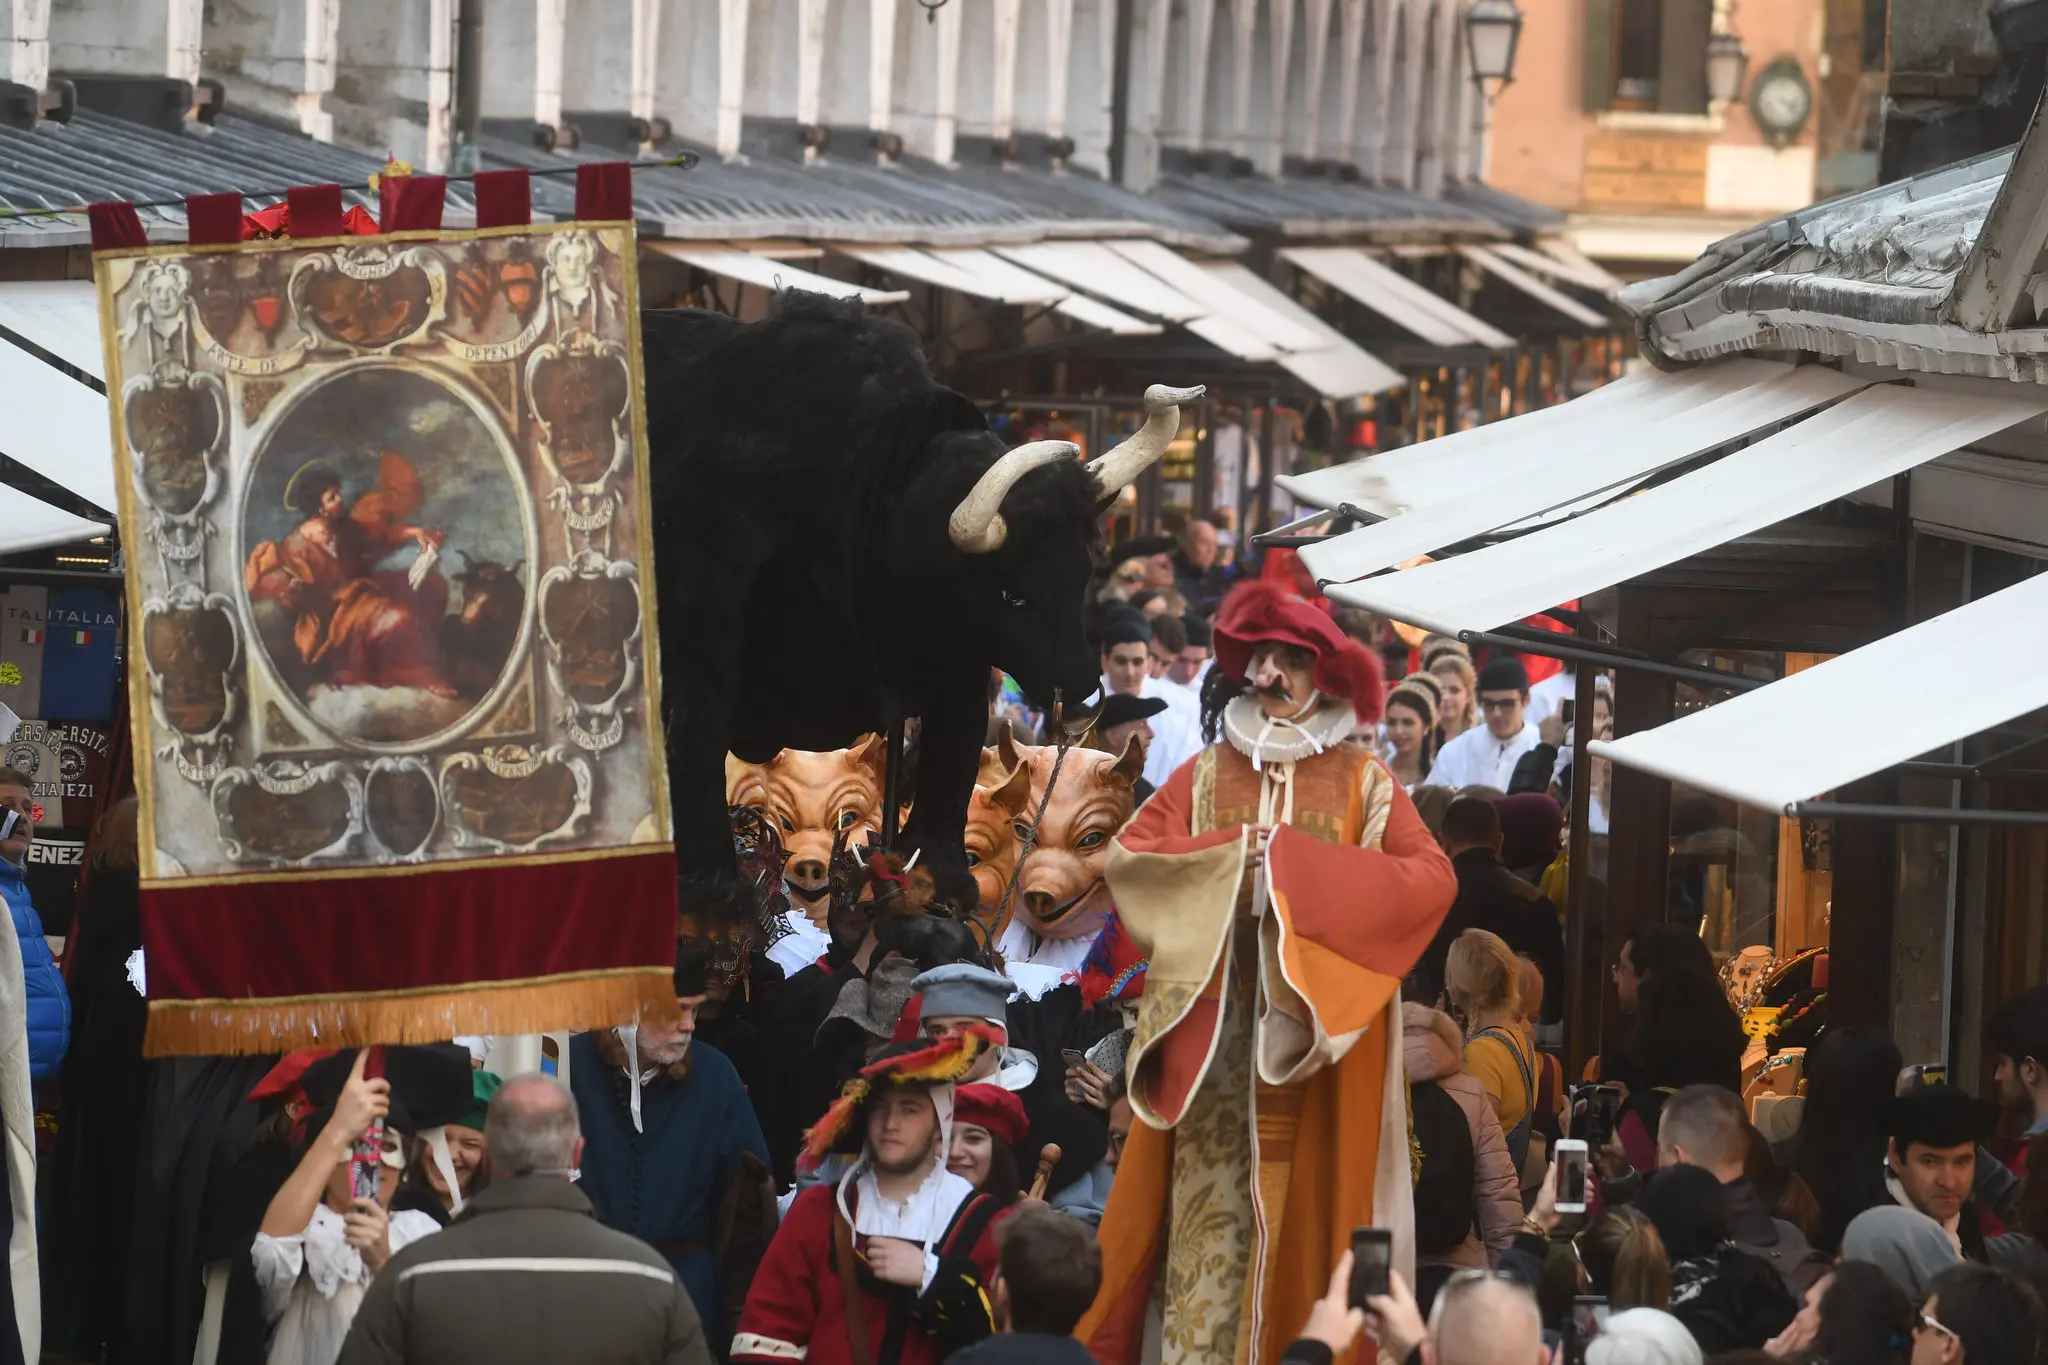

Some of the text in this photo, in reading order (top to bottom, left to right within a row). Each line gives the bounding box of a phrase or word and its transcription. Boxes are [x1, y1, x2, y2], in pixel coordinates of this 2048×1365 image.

[207, 342, 246, 371] ARTE
[48, 609, 115, 625] ITALIA
[27, 845, 84, 865] ENEZ
